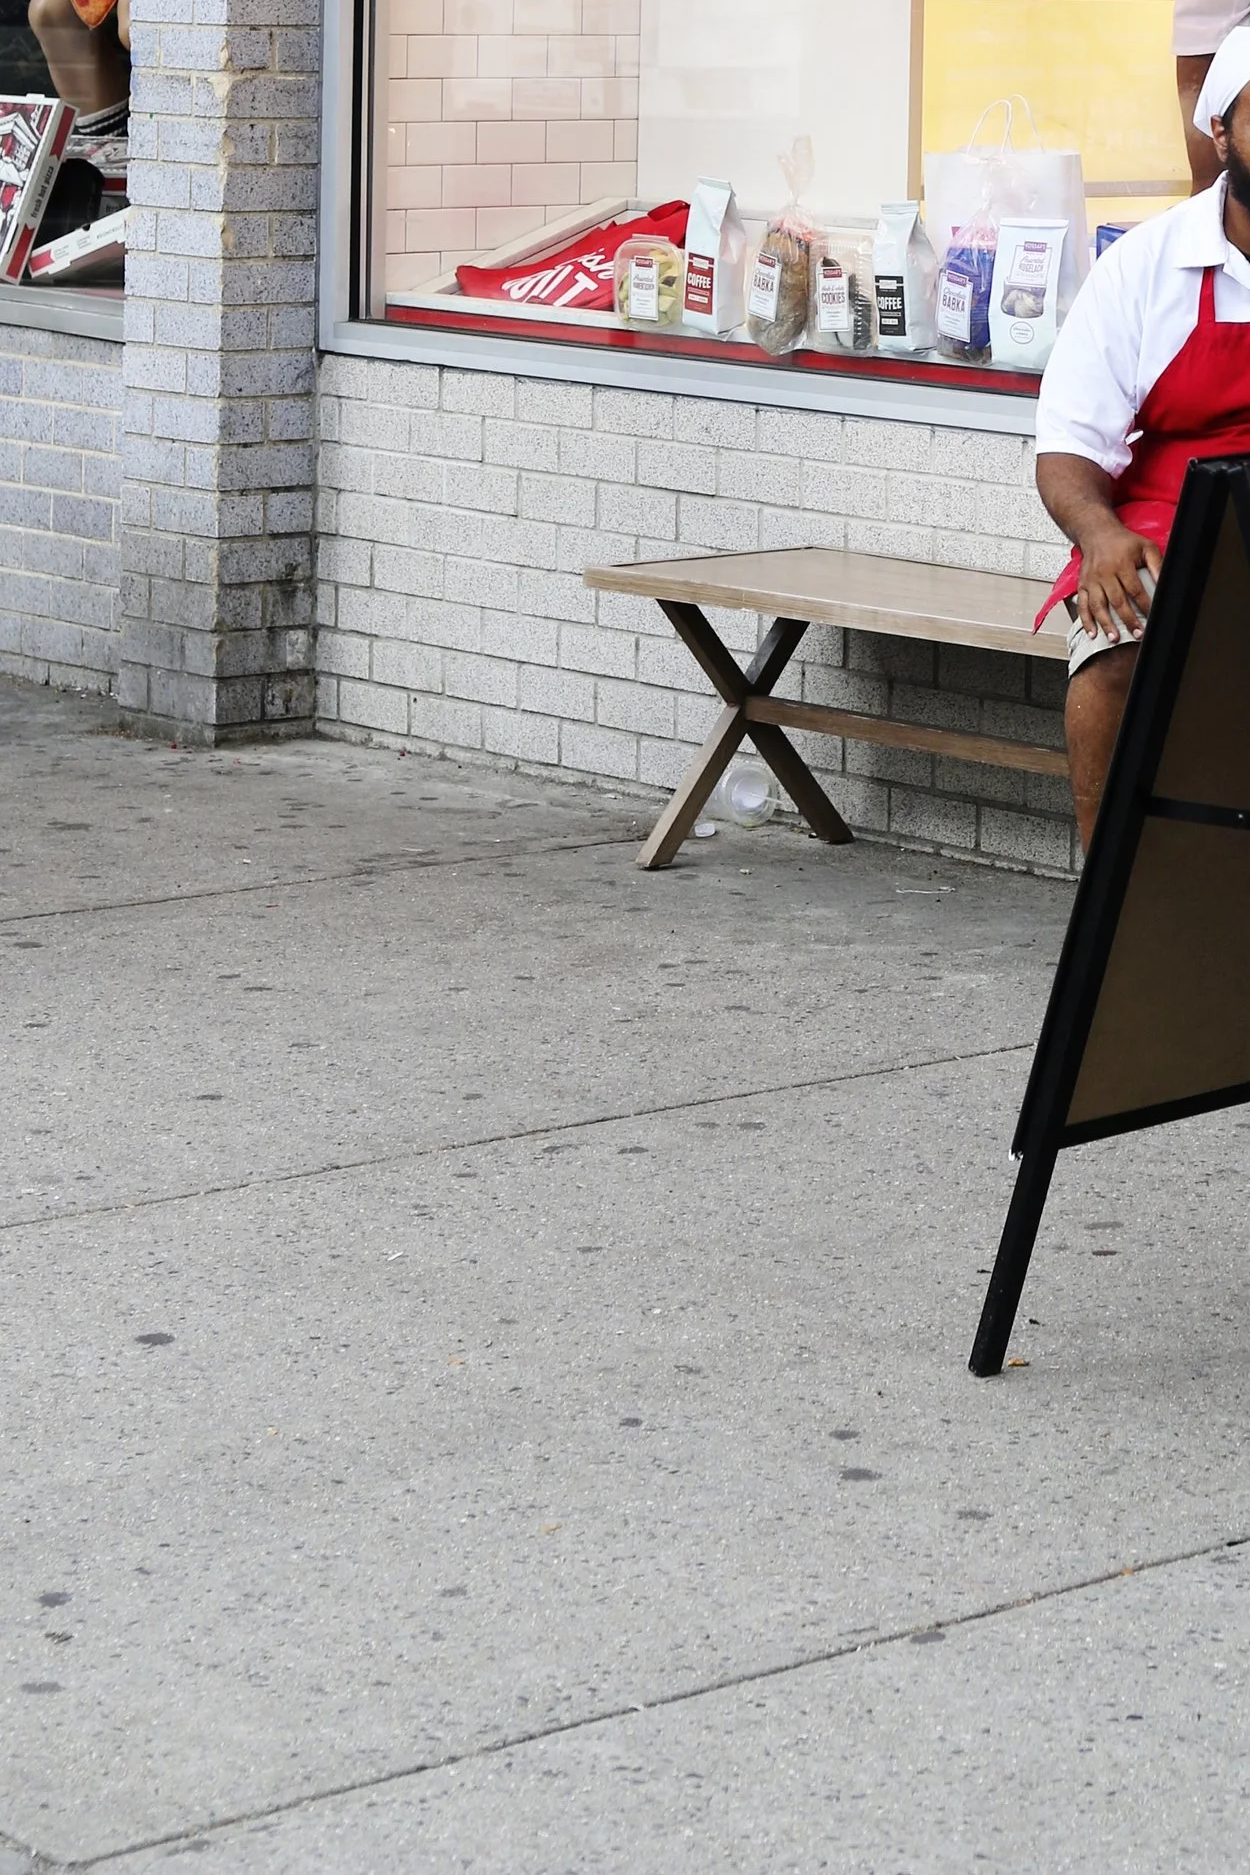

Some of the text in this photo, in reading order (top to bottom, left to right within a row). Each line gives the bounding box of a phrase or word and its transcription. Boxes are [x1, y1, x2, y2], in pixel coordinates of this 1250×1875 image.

[687, 272, 712, 289] COFFEE
[877, 296, 903, 311] COFFEE
[942, 295, 966, 313] BABKA
